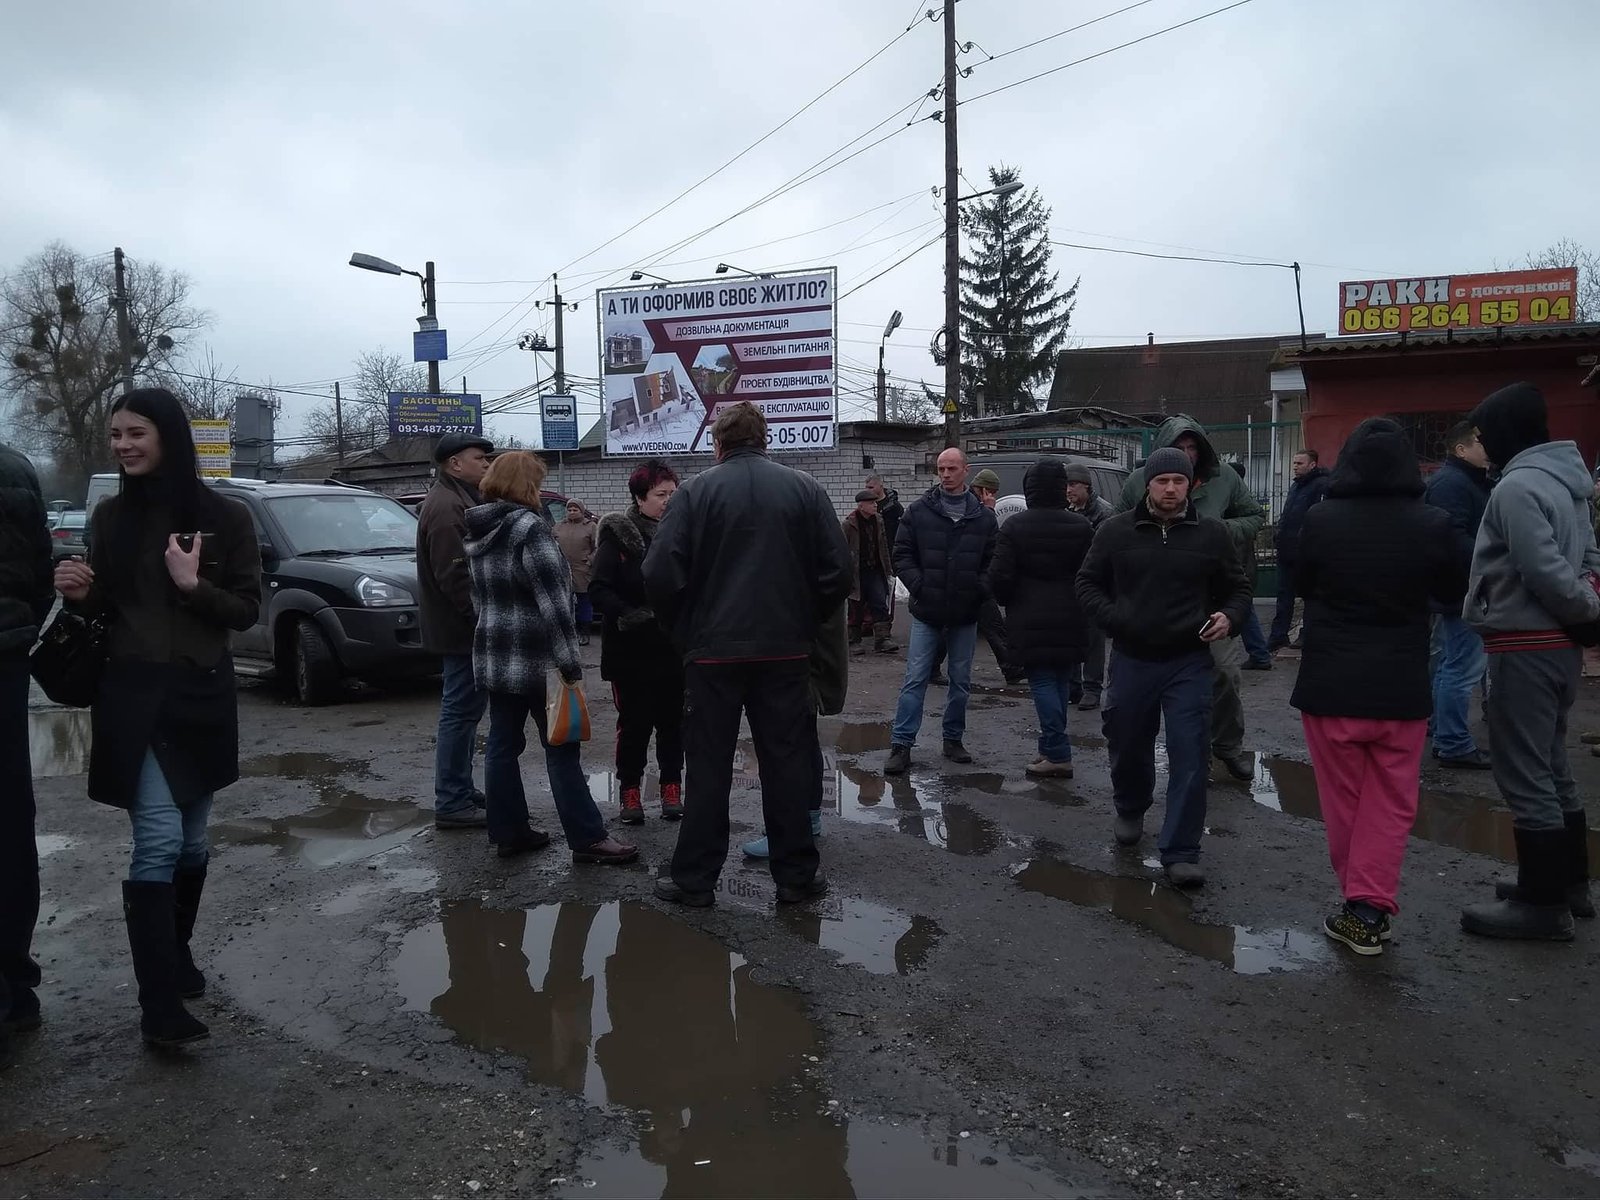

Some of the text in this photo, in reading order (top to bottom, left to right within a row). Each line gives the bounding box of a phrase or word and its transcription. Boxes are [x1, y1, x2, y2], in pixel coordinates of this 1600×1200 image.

[607, 280, 828, 316] А ТИ ОФОРМИВ СВОЄ ЖИТЛО?
[1344, 278, 1572, 308] РАКИ с доставкой
[1343, 296, 1571, 332] 066 264 55 04
[675, 319, 789, 338] ДОЗВІЛЬНА ДОКУМЕНТАЦІЯ
[743, 341, 829, 357] ЗЕМЕЛЬНІ ПИТАННЯ
[741, 375, 829, 388] ПРОЕКТ БУДІВНИЦТВА
[766, 401, 830, 413] ЕКСПЛУАТАЦІЮ
[398, 425, 475, 434] 093-487-27-77
